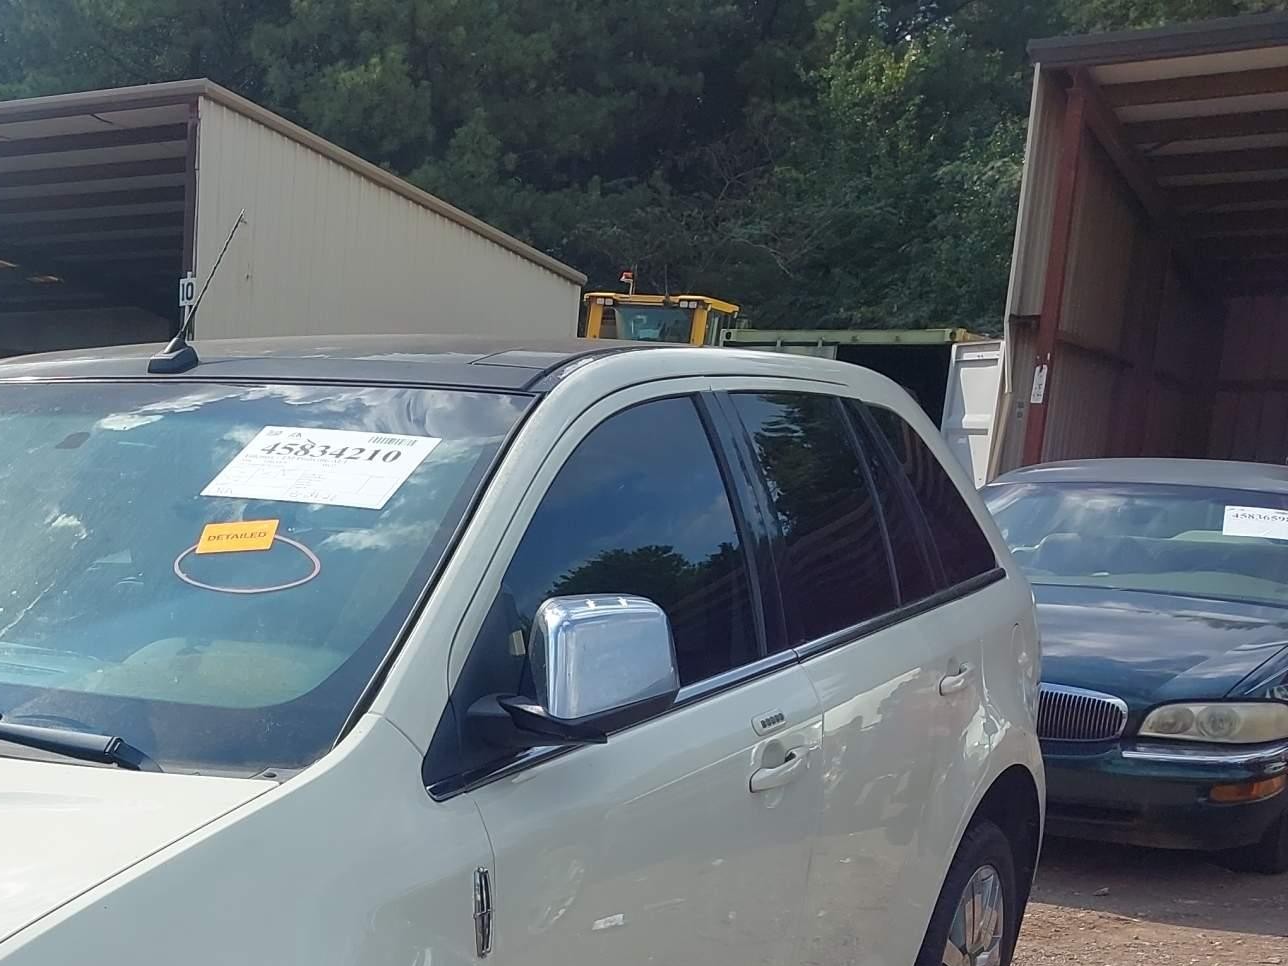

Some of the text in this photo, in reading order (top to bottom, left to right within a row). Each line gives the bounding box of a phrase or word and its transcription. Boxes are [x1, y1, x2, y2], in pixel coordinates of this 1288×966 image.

[181, 281, 194, 302] 10
[260, 441, 402, 464] 45834210
[207, 531, 267, 542] DETAILED
